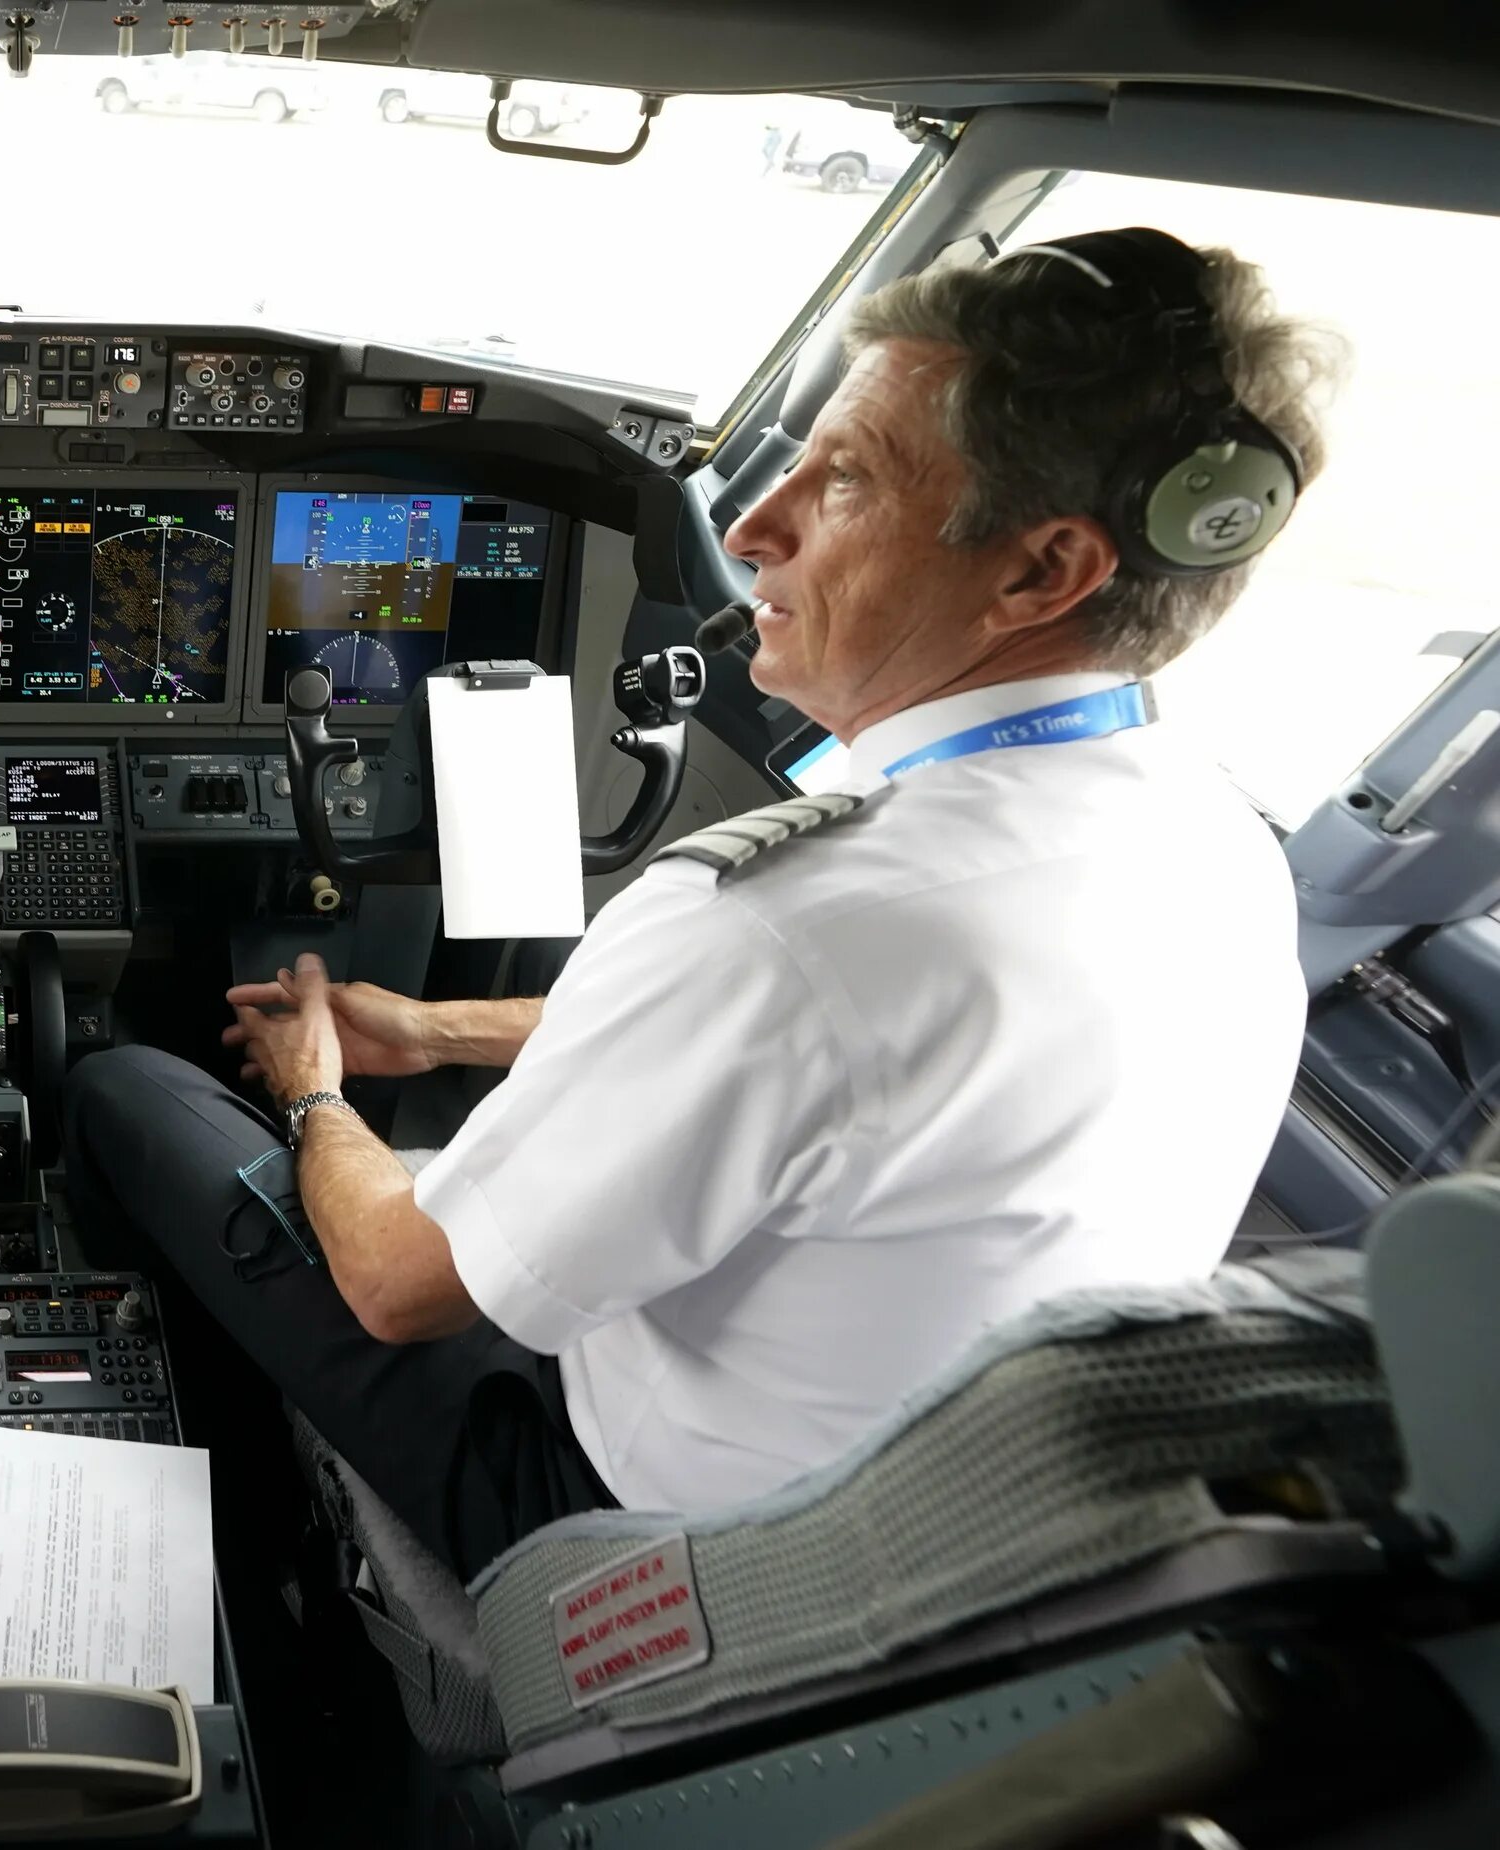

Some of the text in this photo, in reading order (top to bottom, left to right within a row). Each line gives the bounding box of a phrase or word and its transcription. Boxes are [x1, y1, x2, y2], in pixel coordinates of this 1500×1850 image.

[114, 349, 134, 360] 176
[16, 570, 29, 578] 0.0
[991, 724, 1030, 745] It's
[566, 1593, 588, 1620] BACK
[610, 1570, 634, 1595] MUST
[636, 1562, 649, 1583] BE
[616, 1599, 658, 1631] POSITION
[636, 1625, 690, 1662] OUTBOARD
